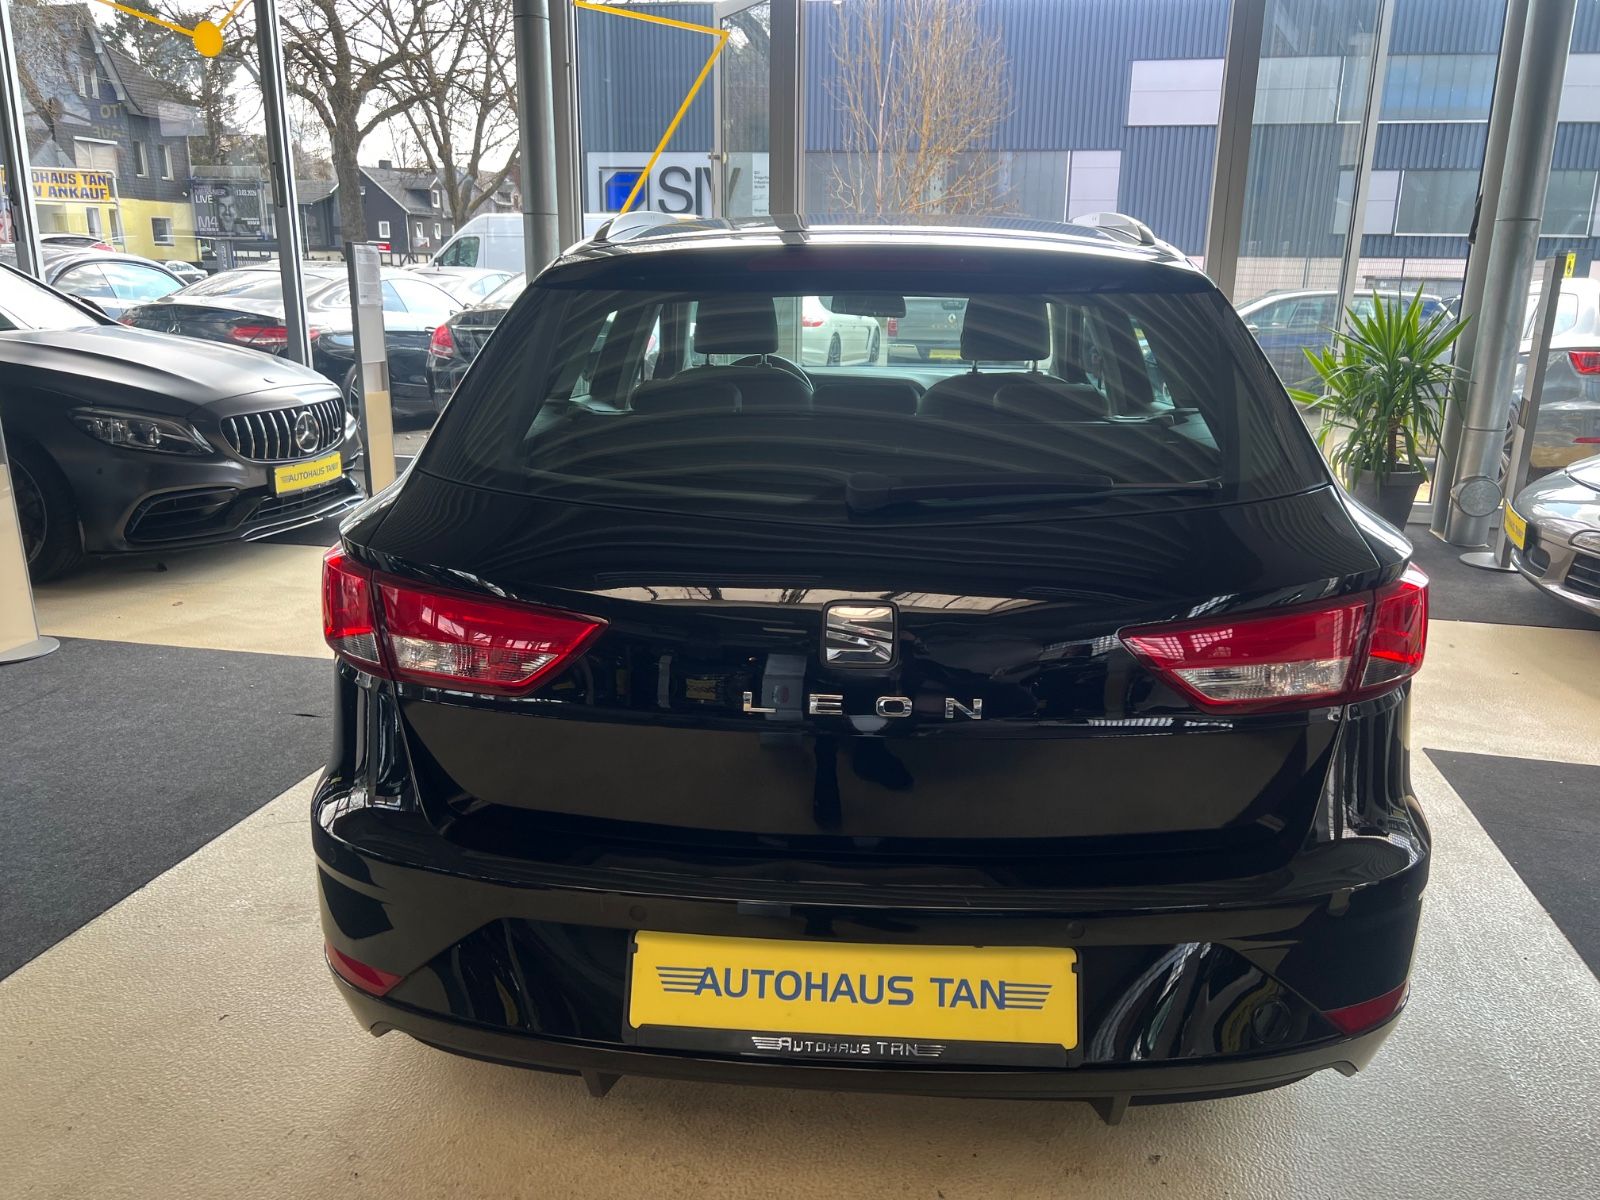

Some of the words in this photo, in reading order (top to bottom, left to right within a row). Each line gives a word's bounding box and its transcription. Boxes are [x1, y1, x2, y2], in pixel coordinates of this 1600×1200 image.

[80, 174, 107, 186] TAN
[48, 185, 108, 199] ANKAUF
[195, 195, 213, 203] LIVE
[197, 215, 219, 228] M4
[288, 467, 325, 482] AUTOHAUS
[743, 691, 983, 720] LEON
[694, 966, 914, 1006] AUTOHAUS
[929, 977, 1006, 1010] TAN
[778, 1037, 871, 1055] AUTOHAUS
[876, 1041, 918, 1057] TAN
